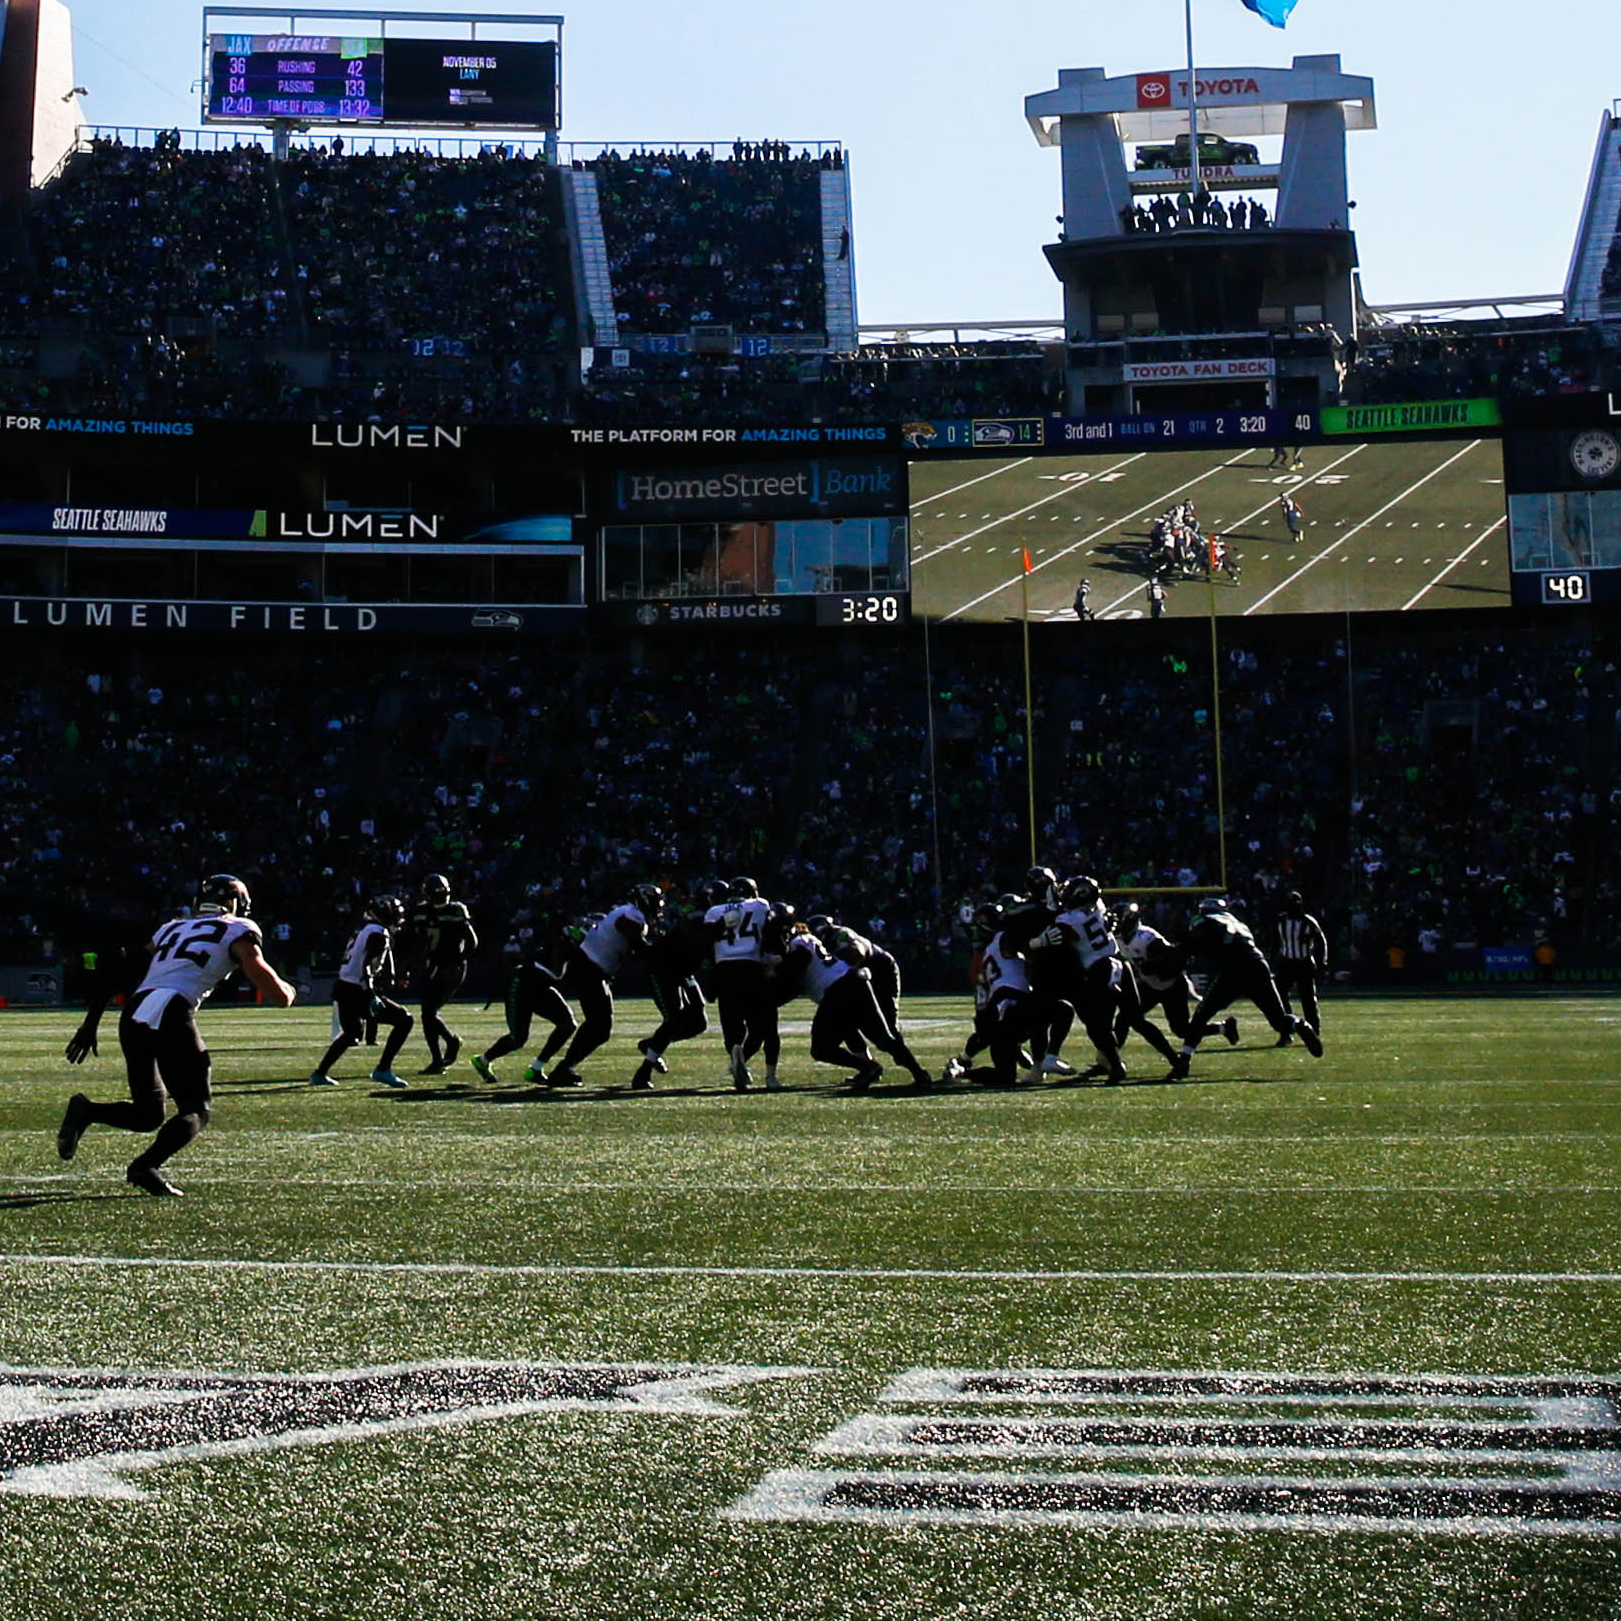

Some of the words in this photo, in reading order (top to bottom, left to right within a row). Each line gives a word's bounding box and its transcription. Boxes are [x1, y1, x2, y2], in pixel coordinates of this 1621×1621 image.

[227, 36, 252, 53] JAX
[266, 35, 330, 51] OFFENSE
[229, 57, 246, 74] 36
[278, 60, 316, 74] RUSHING
[347, 60, 363, 77] 42
[443, 56, 484, 69] NOVEMBER
[486, 57, 497, 69] 05
[229, 78, 245, 93] 64
[278, 80, 315, 94] PASSING
[345, 80, 366, 97] 133
[1178, 78, 1259, 97] TOYOTA
[221, 97, 253, 114] 12:40
[268, 99, 287, 114] TIME
[339, 99, 370, 116] 13:32
[748, 337, 767, 355] 12
[1131, 366, 1188, 378] TOYOTA
[1194, 364, 1222, 375] FAN
[1228, 362, 1268, 374] DECK
[1240, 416, 1266, 433] 3:20
[1295, 414, 1310, 430] 40
[1346, 407, 1398, 429] SEATTLE
[1401, 404, 1468, 425] SEAHAWKS
[5, 414, 42, 432] FOR
[46, 417, 127, 435] AMAZING
[132, 419, 194, 437] THINGS
[947, 425, 956, 443] 0
[1018, 424, 1031, 440] 14
[1065, 423, 1085, 440] 3rd
[1086, 423, 1107, 439] and
[1163, 419, 1175, 436] 21
[1216, 418, 1224, 434] 2
[311, 424, 462, 449] LUMEN
[570, 429, 605, 443] THE
[609, 429, 698, 443] PLATFORM
[702, 429, 737, 443] FOR
[741, 428, 820, 443] AMAZING
[824, 426, 887, 442] THINGS
[630, 473, 808, 501] HomeStreet
[824, 466, 891, 494] Bank
[51, 506, 99, 532] SEATTLE
[101, 508, 167, 534] SEAHAWKS
[279, 511, 439, 539] LUMEN
[1548, 575, 1584, 600] 40
[13, 601, 189, 630] LUMEN
[230, 606, 378, 632] FIELD
[669, 603, 782, 621] STARBUCKS
[842, 596, 898, 624] 3:20
[154, 920, 229, 968] 42
